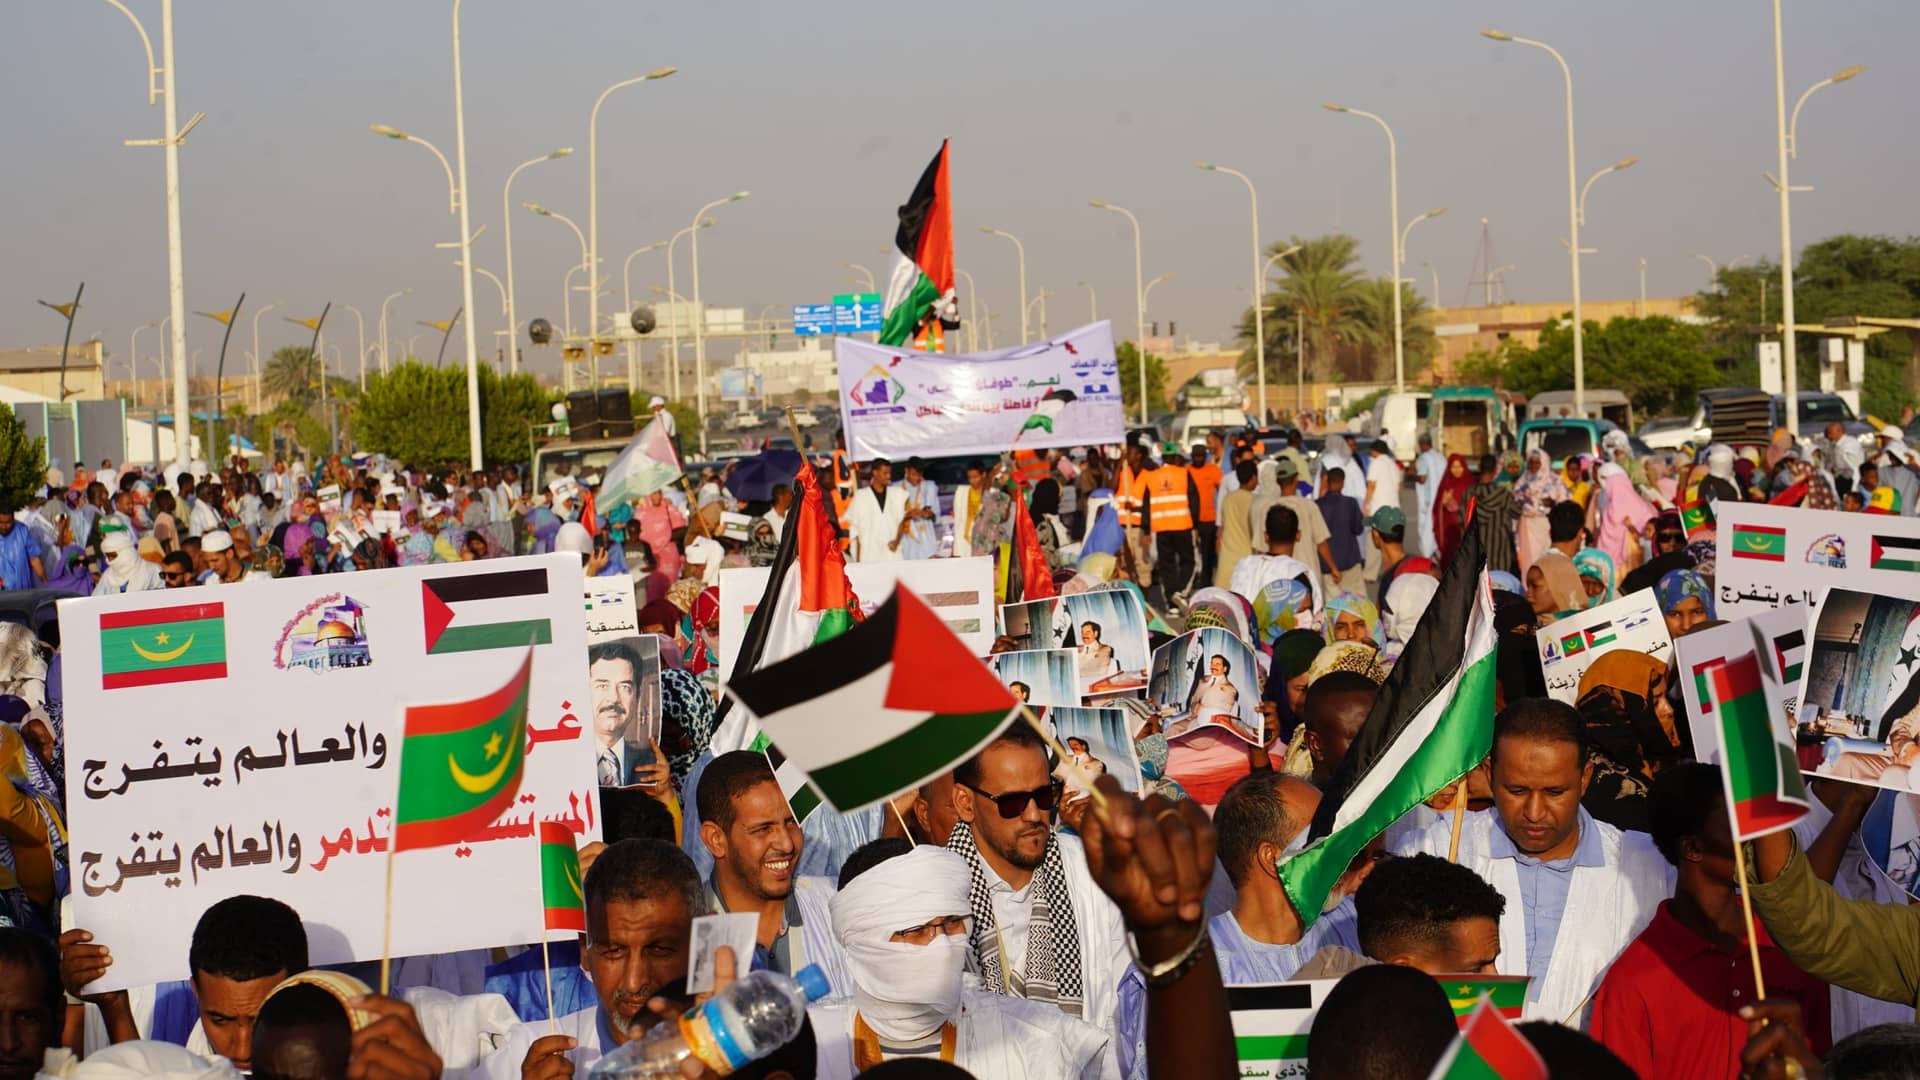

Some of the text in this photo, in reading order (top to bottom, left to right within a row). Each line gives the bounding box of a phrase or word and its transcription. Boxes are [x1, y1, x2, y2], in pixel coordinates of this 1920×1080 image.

[1720, 583, 1779, 608] يتفرج
[82, 736, 222, 800] يتفرج
[234, 721, 388, 785] والعالم
[80, 829, 182, 897] يتفرج
[191, 819, 302, 886] والعالم
